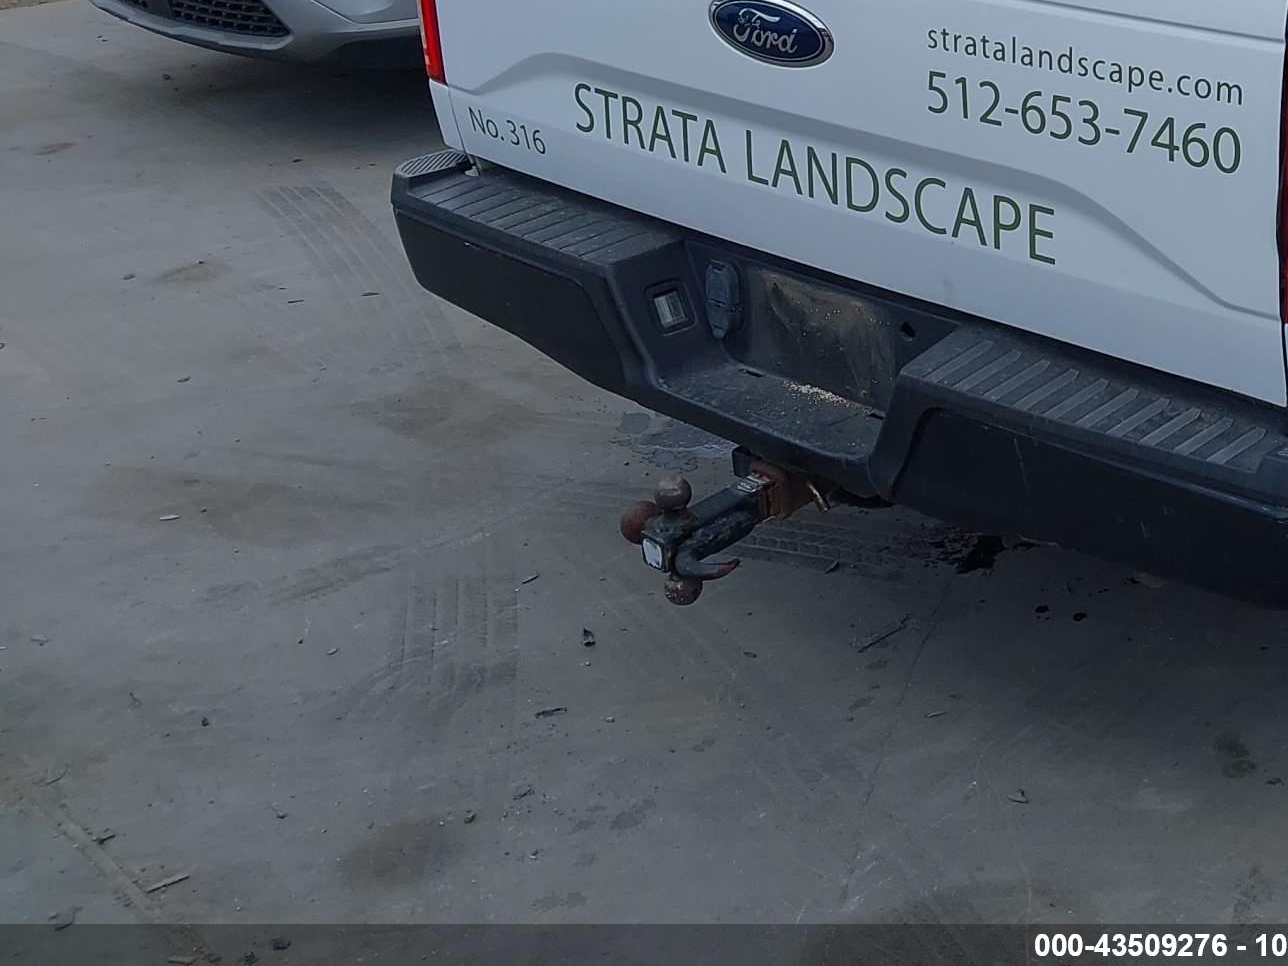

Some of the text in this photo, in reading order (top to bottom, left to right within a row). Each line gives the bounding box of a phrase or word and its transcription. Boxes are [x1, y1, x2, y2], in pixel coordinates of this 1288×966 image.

[733, 7, 799, 54] Ford
[927, 27, 1243, 106] stratalandscape.com
[927, 70, 1241, 174] 512-653-7460
[573, 82, 1056, 265] STRATA LANDSCAPE
